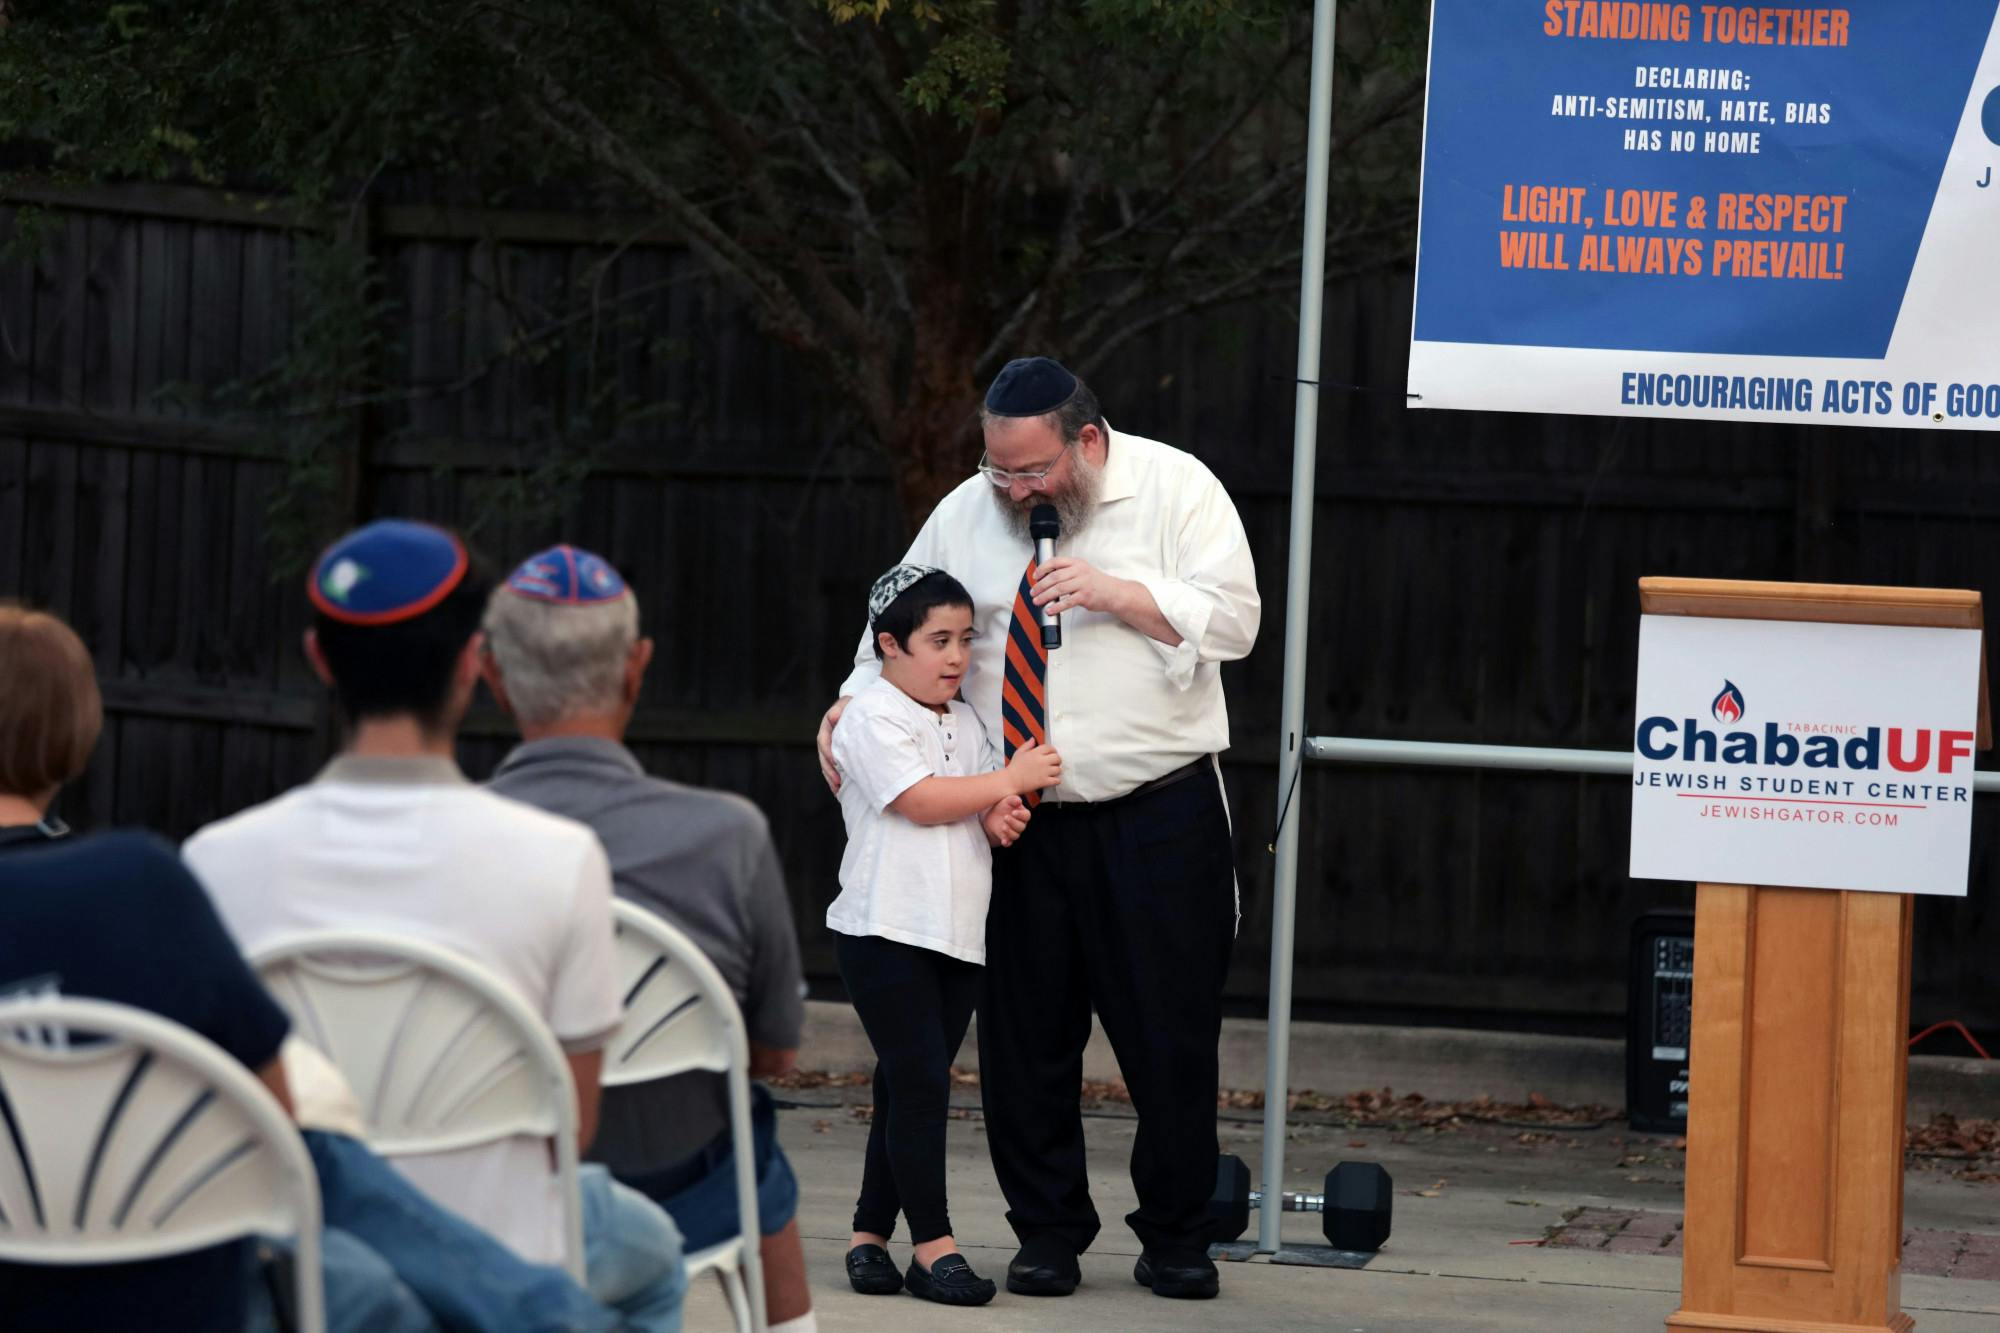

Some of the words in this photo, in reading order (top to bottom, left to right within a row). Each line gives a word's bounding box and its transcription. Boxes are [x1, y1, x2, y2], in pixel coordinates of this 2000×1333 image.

[1543, 0, 1691, 42] STANDING
[1702, 5, 1850, 47] TOGETHER
[1635, 66, 1751, 91] DECLARING;
[1551, 94, 1712, 123] ANTI-SEMITISM,
[1720, 100, 1776, 125] HATE,
[1785, 103, 1831, 124] BIAS
[1623, 129, 1662, 152] HAS
[1670, 130, 1696, 152] NO
[1704, 131, 1761, 154] HOME
[1502, 184, 1593, 230] LIGHT,
[1604, 188, 1678, 228] LOVE
[1686, 195, 1707, 230] &
[1717, 193, 1848, 233] RESPECT
[1500, 231, 1569, 271] WILL
[1578, 235, 1704, 276] ALWAYS
[1712, 239, 1845, 280] PREVAIL!
[1621, 372, 1813, 413] ENCOURAGING
[1821, 379, 1893, 415] ACTS
[1902, 381, 1937, 416] OF
[1786, 722, 1857, 735] TABACINIC
[1635, 771, 1727, 791] JEWISH
[1740, 777, 1854, 797] STUDENT
[1868, 783, 1968, 802] CENTER
[1700, 804, 1899, 827] JEWISHGATOR.COM
